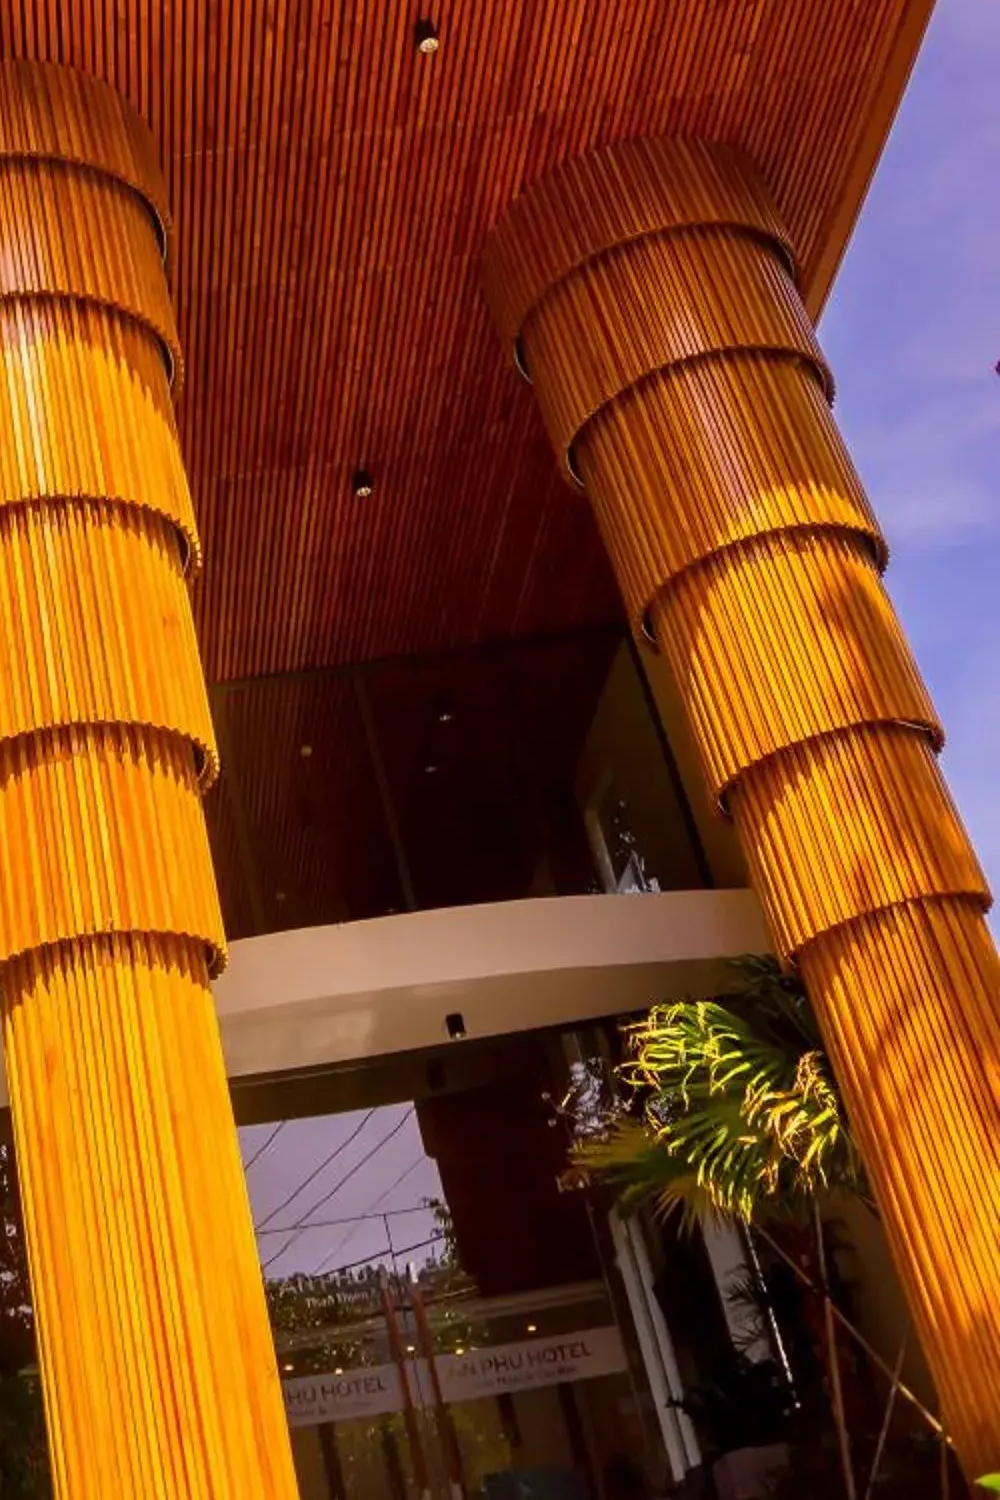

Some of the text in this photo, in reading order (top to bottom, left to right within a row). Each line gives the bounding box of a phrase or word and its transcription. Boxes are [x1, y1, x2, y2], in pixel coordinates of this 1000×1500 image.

[527, 1340, 594, 1366] HOTEL
[287, 1375, 386, 1405] HU HOTEL
